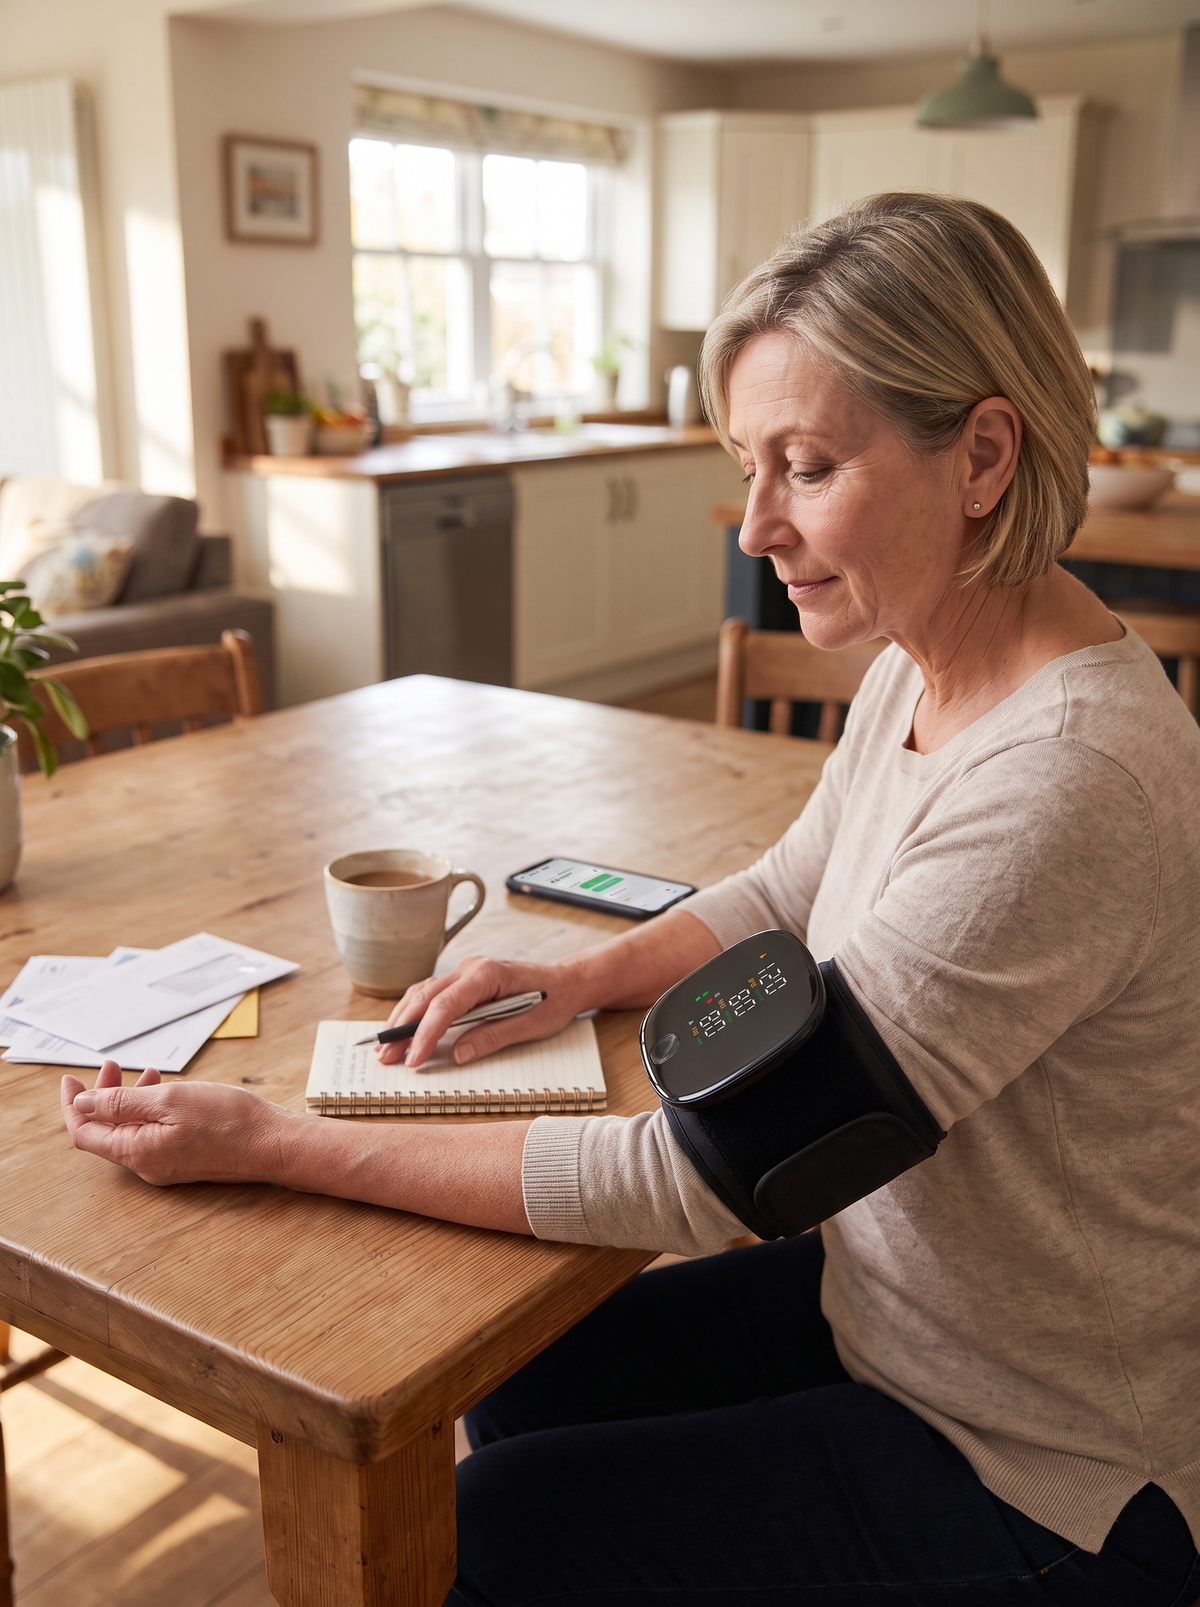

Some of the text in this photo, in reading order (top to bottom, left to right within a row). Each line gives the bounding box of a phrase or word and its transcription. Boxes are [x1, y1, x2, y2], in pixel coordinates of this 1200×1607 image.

[758, 962, 787, 995] 120
[728, 988, 756, 1017] 80
[699, 1009, 726, 1038] 80
